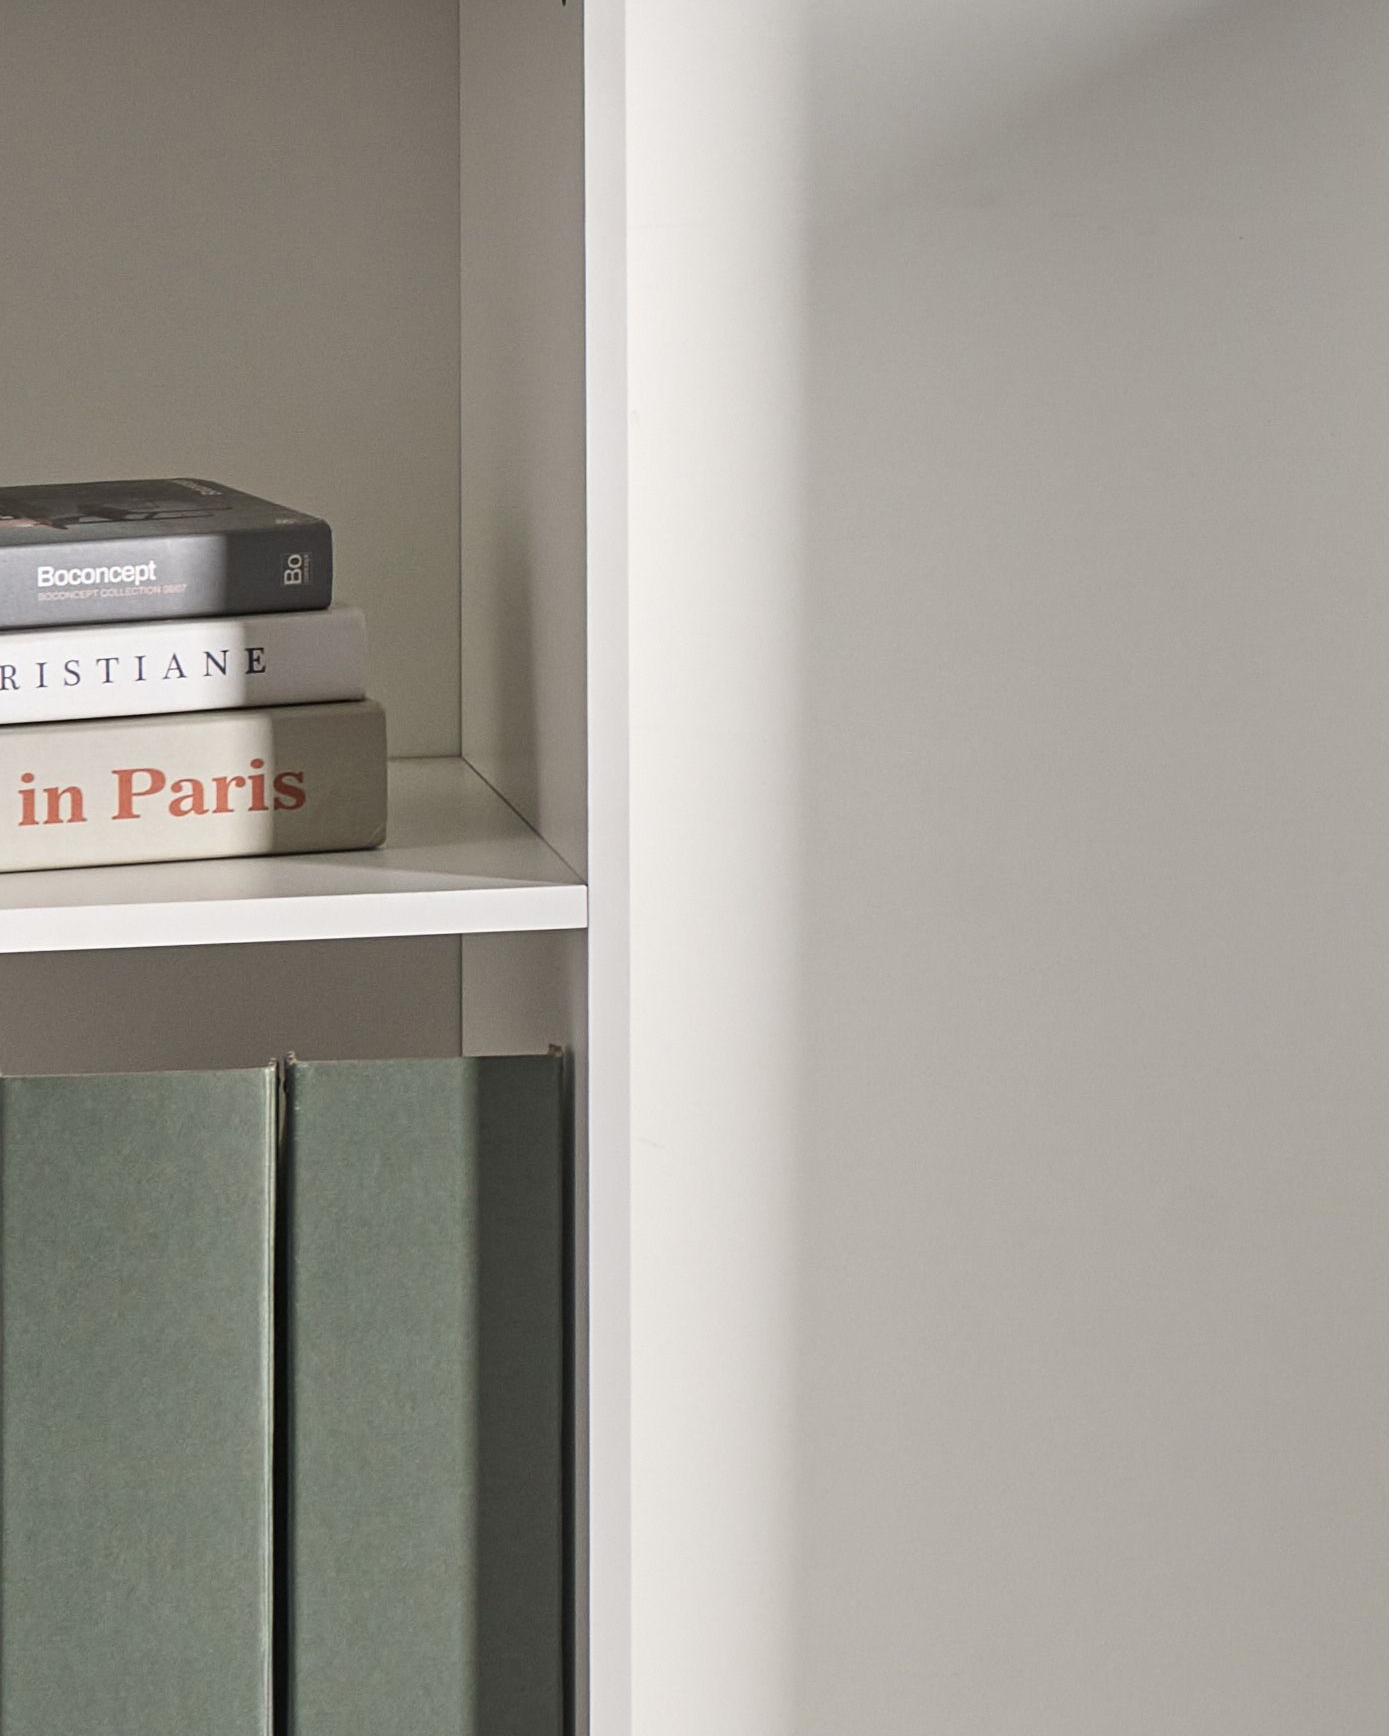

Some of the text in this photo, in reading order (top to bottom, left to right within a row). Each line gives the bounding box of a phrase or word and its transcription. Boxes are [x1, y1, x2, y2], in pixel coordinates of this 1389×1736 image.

[37, 560, 157, 587] Boconcept
[284, 554, 302, 584] Bo
[18, 759, 306, 826] in Paris
